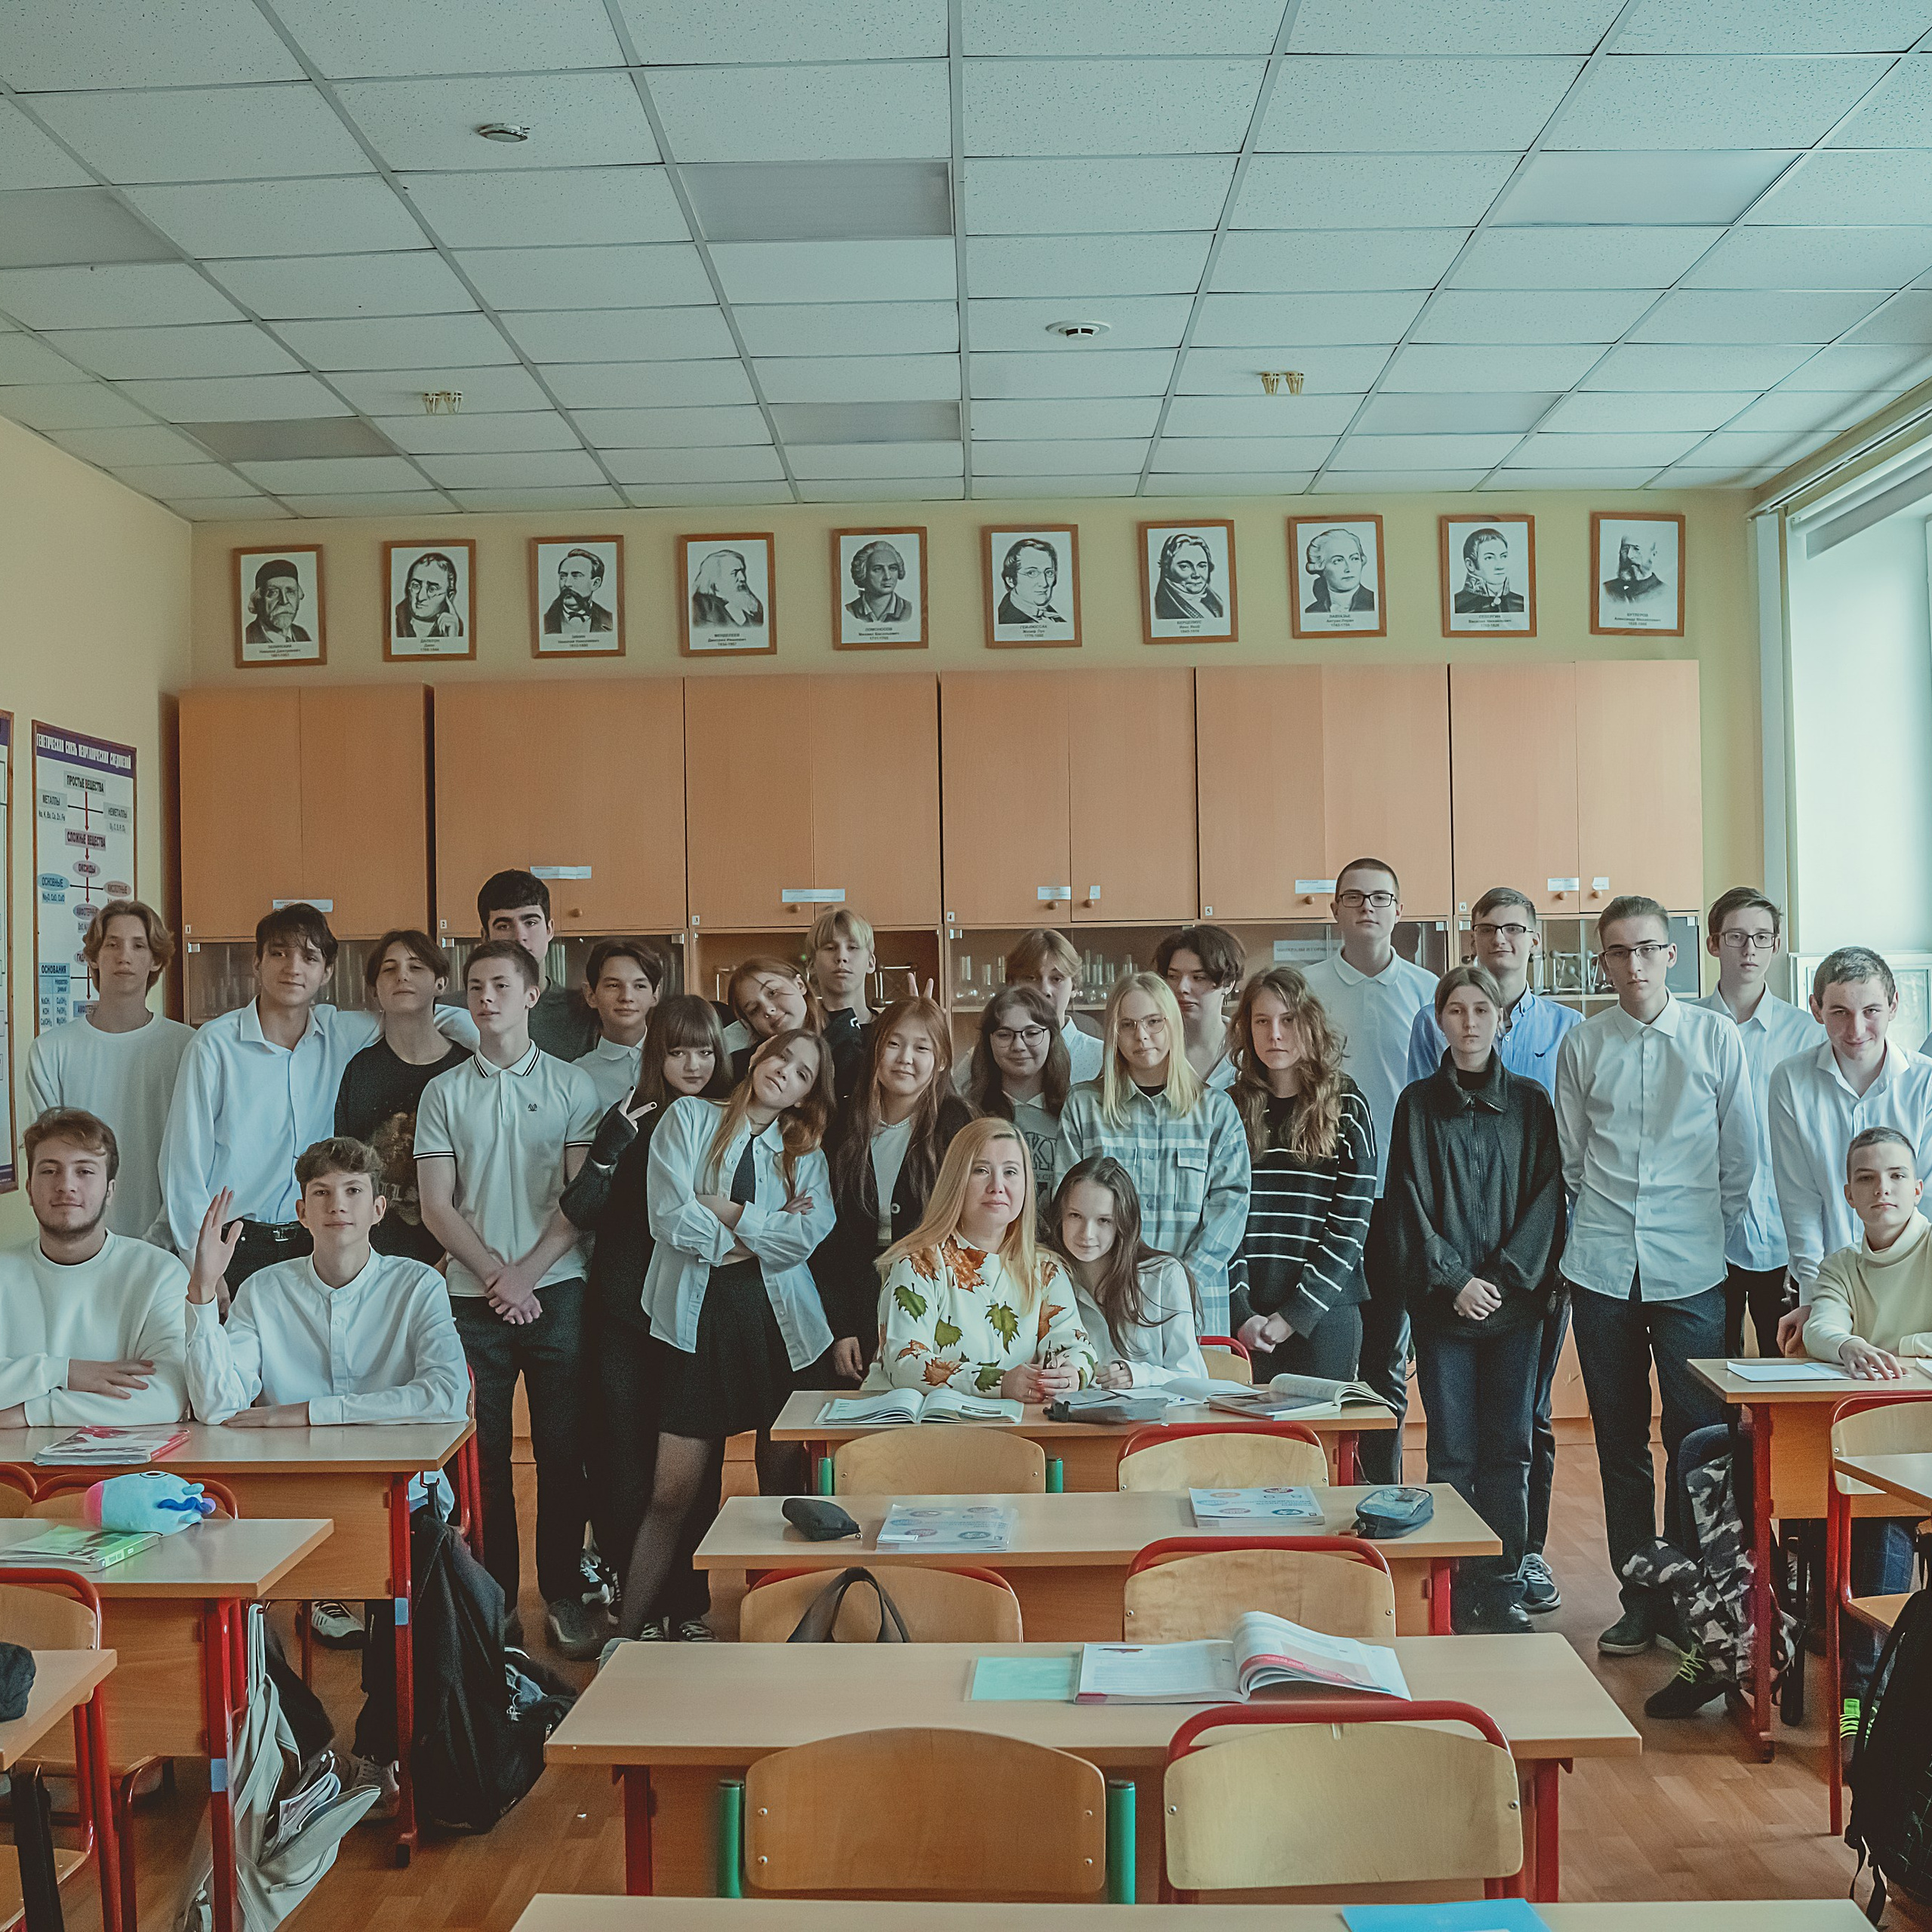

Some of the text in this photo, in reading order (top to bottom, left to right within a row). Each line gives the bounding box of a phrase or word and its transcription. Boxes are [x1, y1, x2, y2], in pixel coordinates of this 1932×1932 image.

[67, 775, 105, 793] ПРОСТЫЕ ВЕЩЕСТВА
[42, 795, 60, 806] МЕТАЛЛЫ
[108, 808, 128, 819] НЕМЕТАЛЛЫ
[67, 831, 106, 848] СЛОЖНЫЕ ВЕЩЕСТВА
[78, 863, 96, 875] ОКСИДЫ
[42, 877, 63, 888] ОСНОВНЫЕ
[42, 965, 66, 974] ОСНОВАНИЯ
